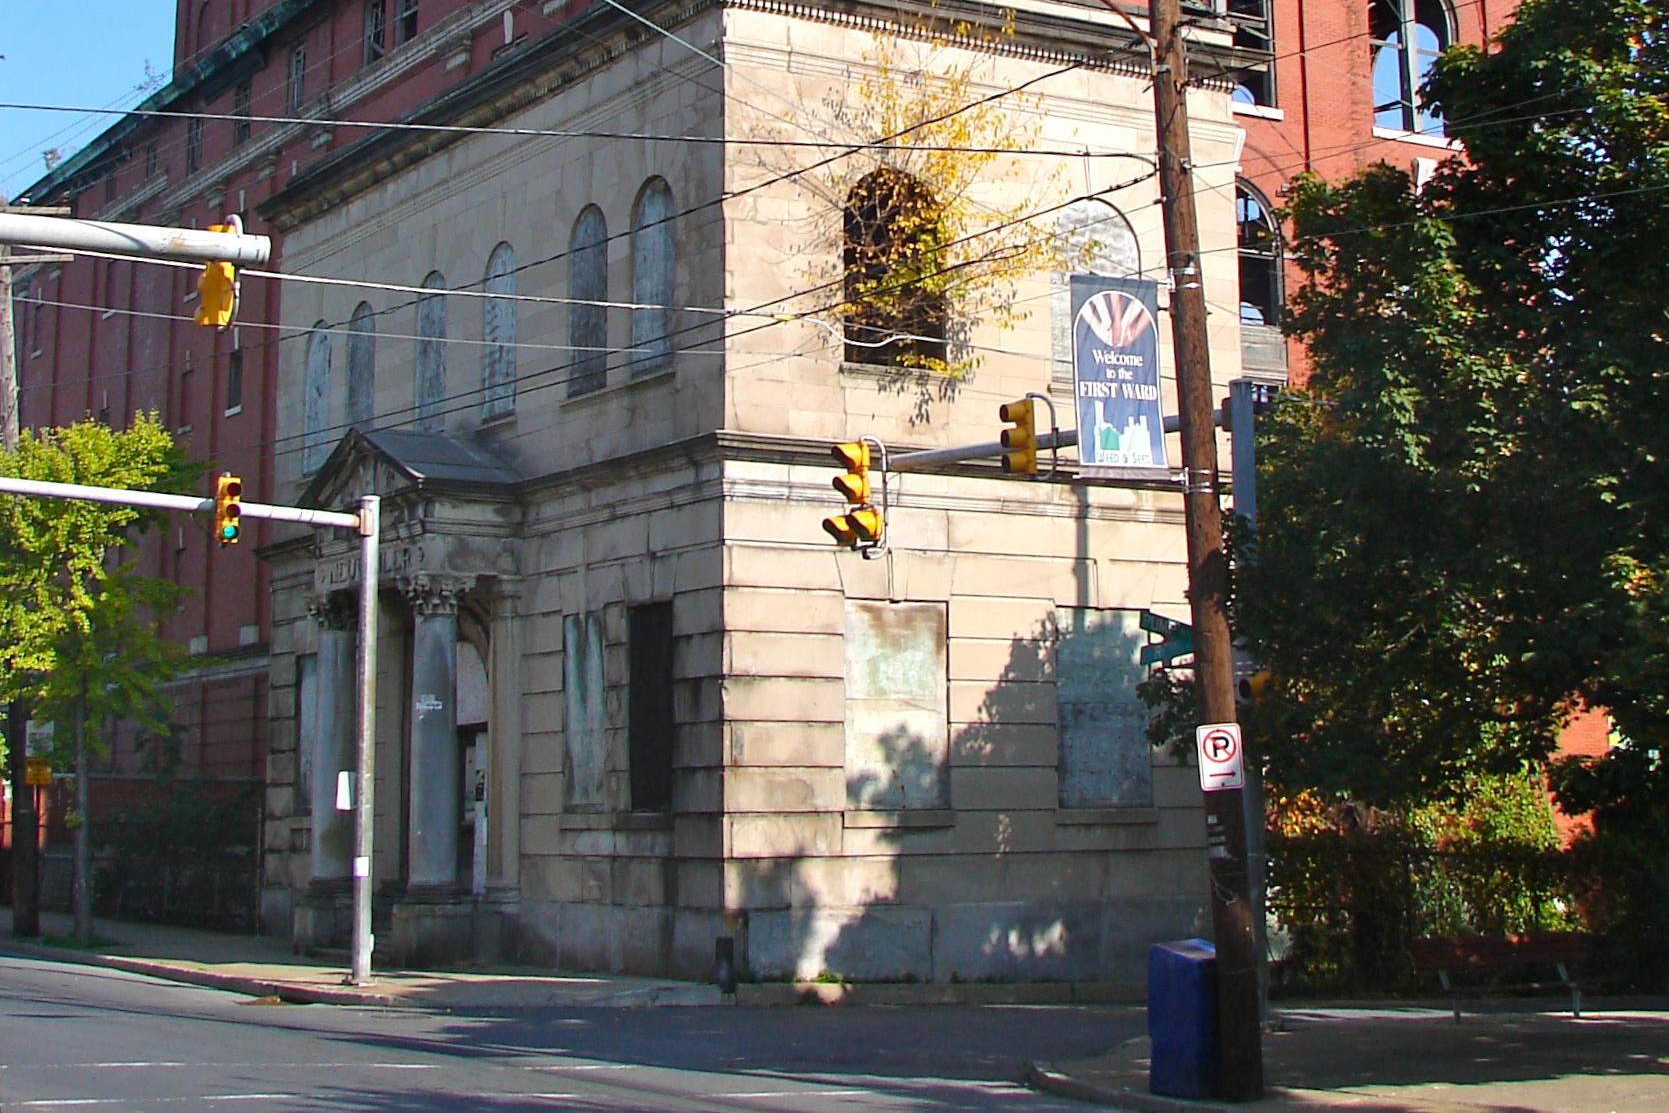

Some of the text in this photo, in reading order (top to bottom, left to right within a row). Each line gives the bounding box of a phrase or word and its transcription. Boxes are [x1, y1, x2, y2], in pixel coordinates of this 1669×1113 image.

[1092, 349, 1144, 367] Welcome
[1106, 368, 1134, 380] to the
[1080, 381, 1158, 401] FIRST WARD
